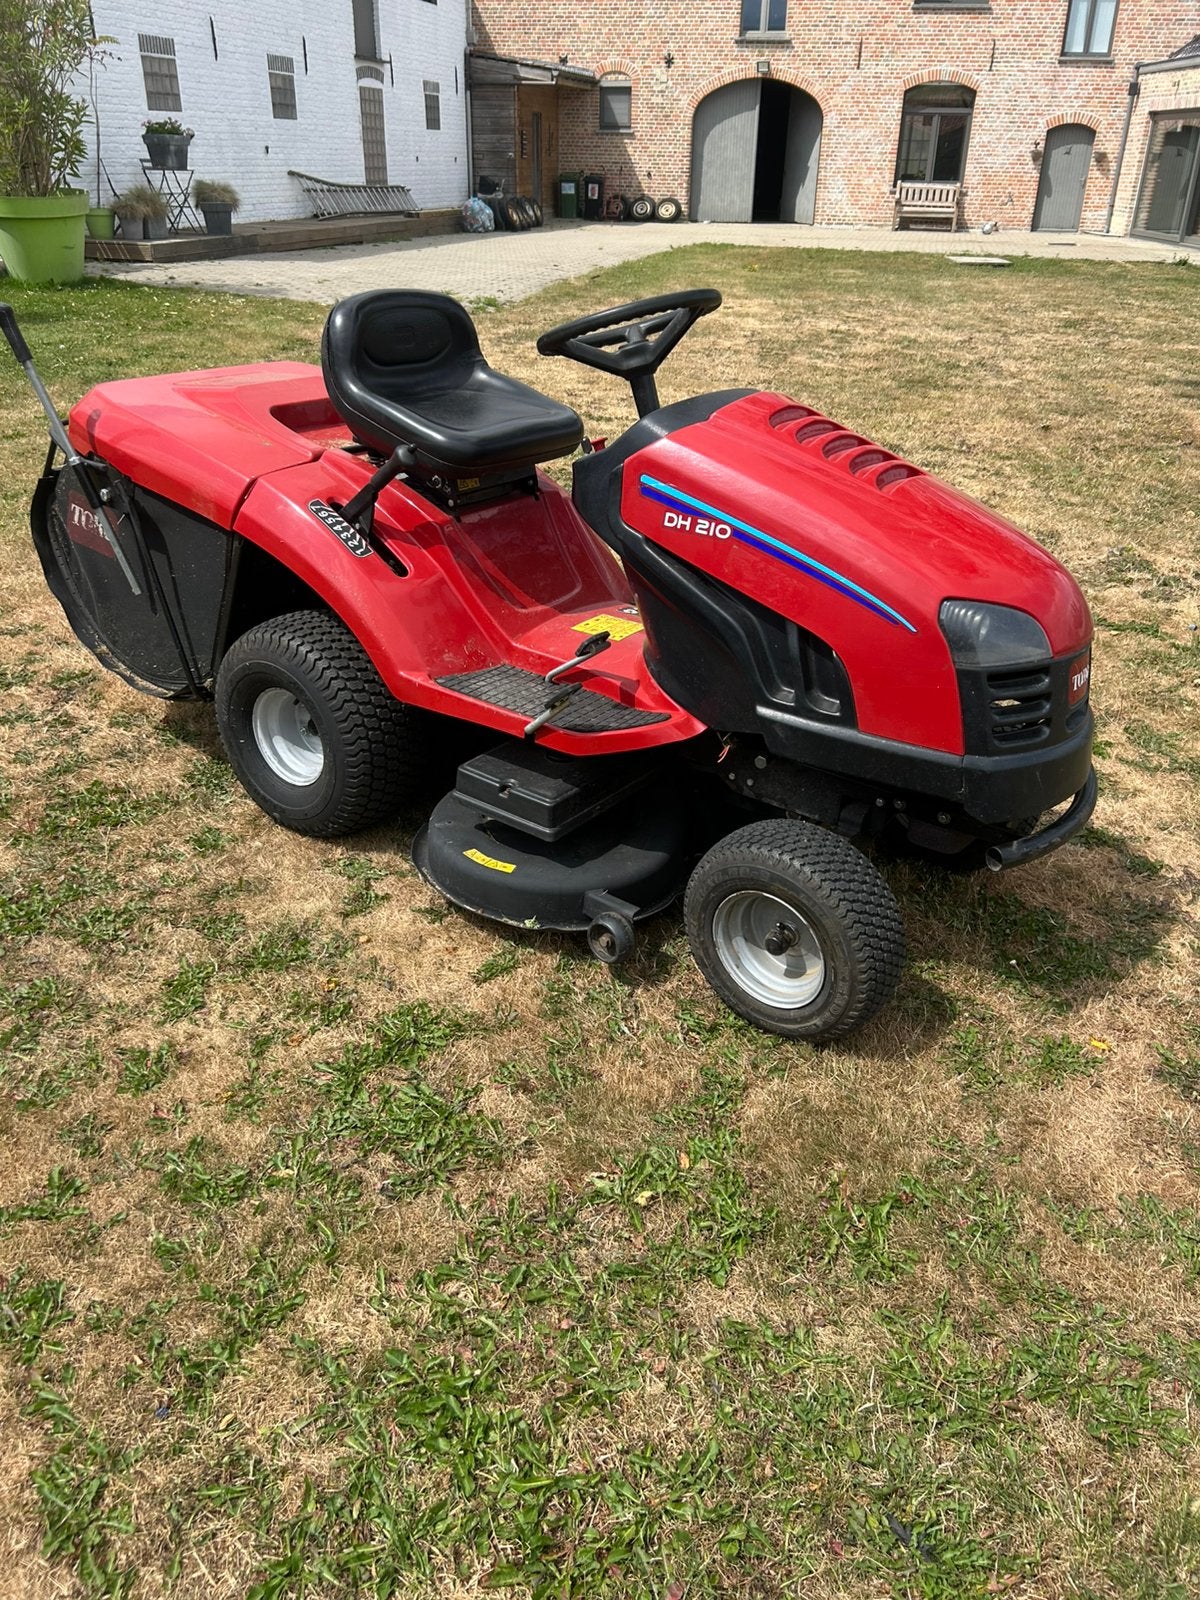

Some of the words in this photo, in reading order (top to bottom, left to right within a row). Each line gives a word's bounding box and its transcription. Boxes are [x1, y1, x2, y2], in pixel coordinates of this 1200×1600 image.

[71, 503, 111, 542] TO
[663, 512, 692, 531] DH
[695, 518, 731, 539] 210
[1072, 664, 1089, 691] TOR
